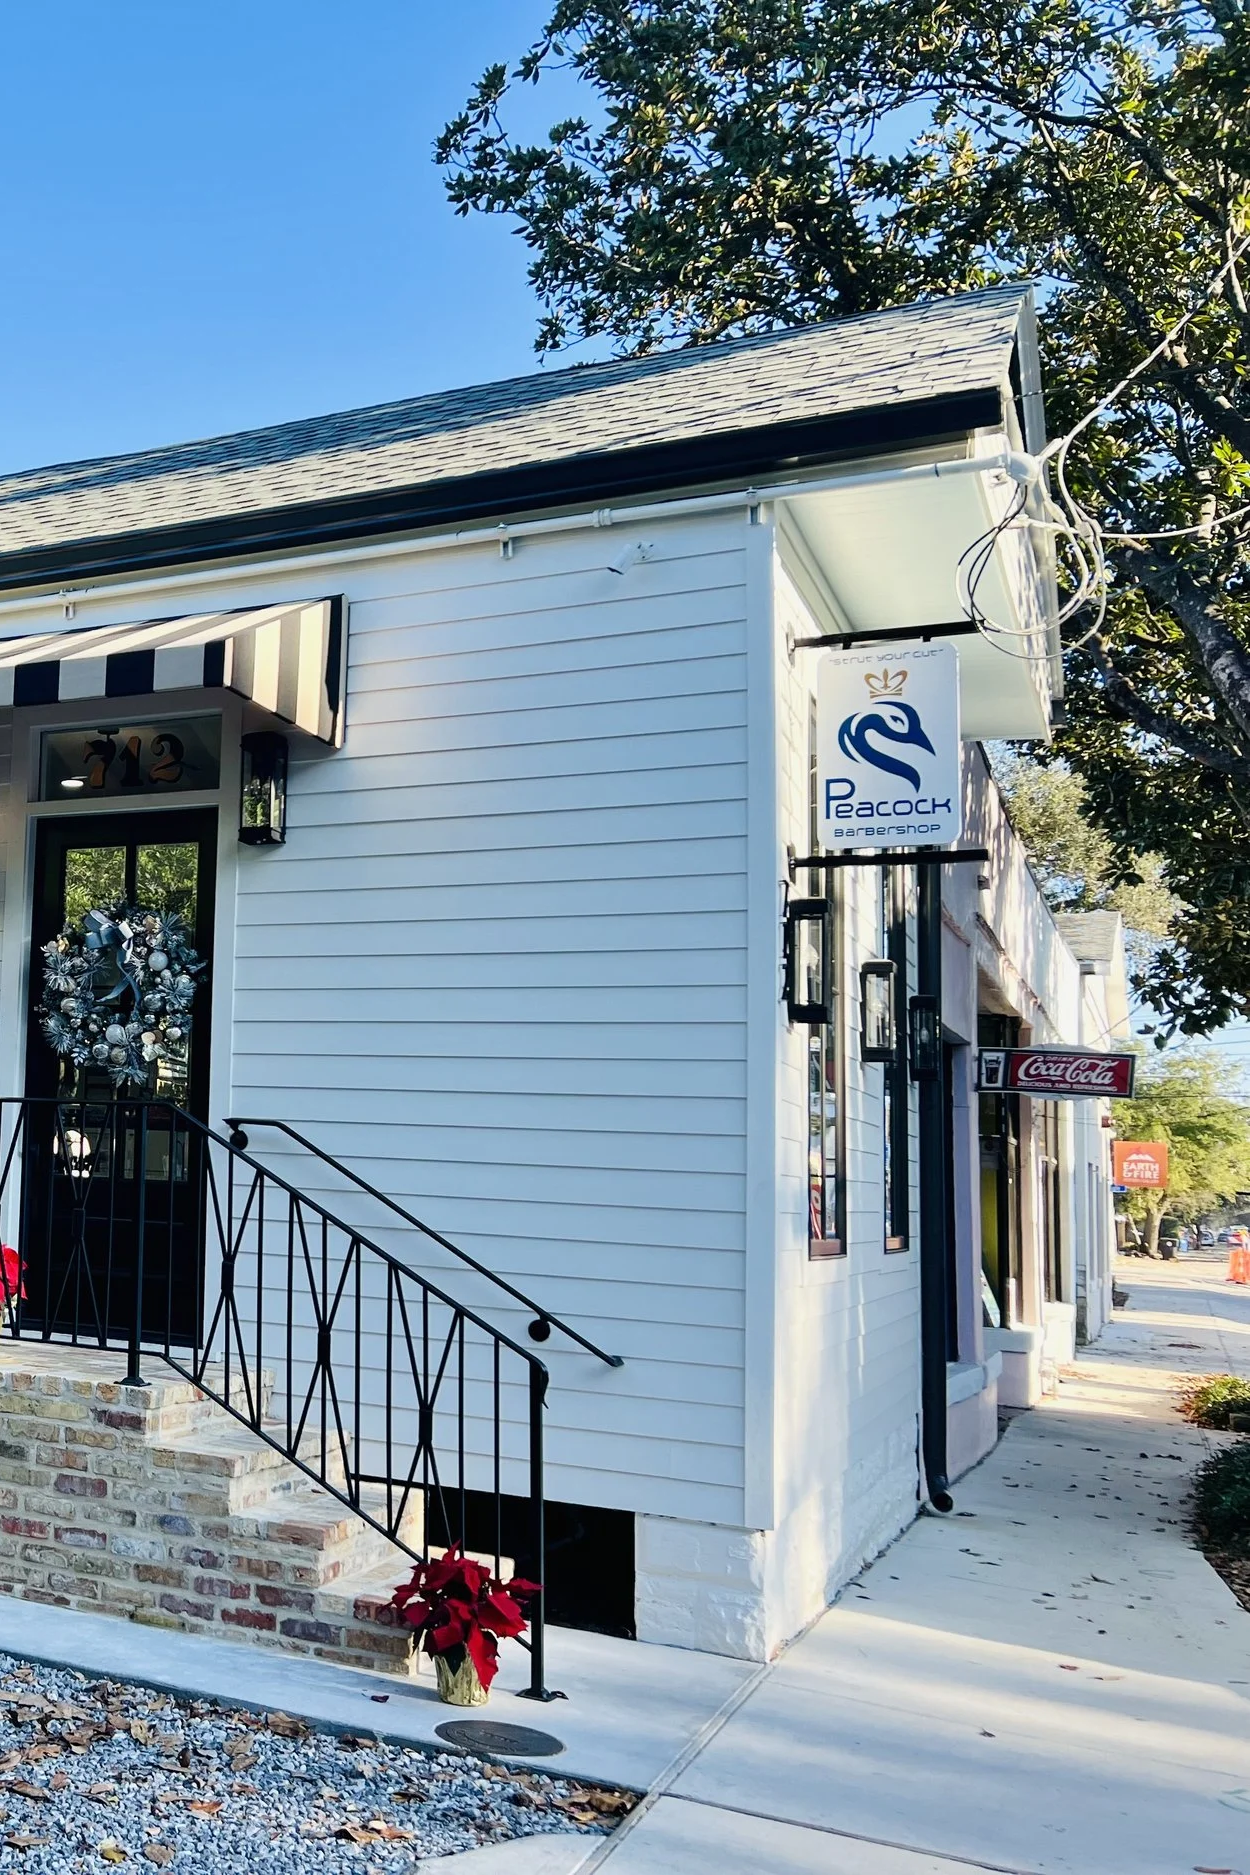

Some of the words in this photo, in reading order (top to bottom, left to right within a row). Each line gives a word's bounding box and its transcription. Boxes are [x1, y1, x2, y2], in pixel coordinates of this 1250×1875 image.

[877, 651, 910, 662] your
[83, 733, 184, 789] 712
[825, 778, 952, 820] Peacock
[1123, 1162, 1159, 1171] EARTH
